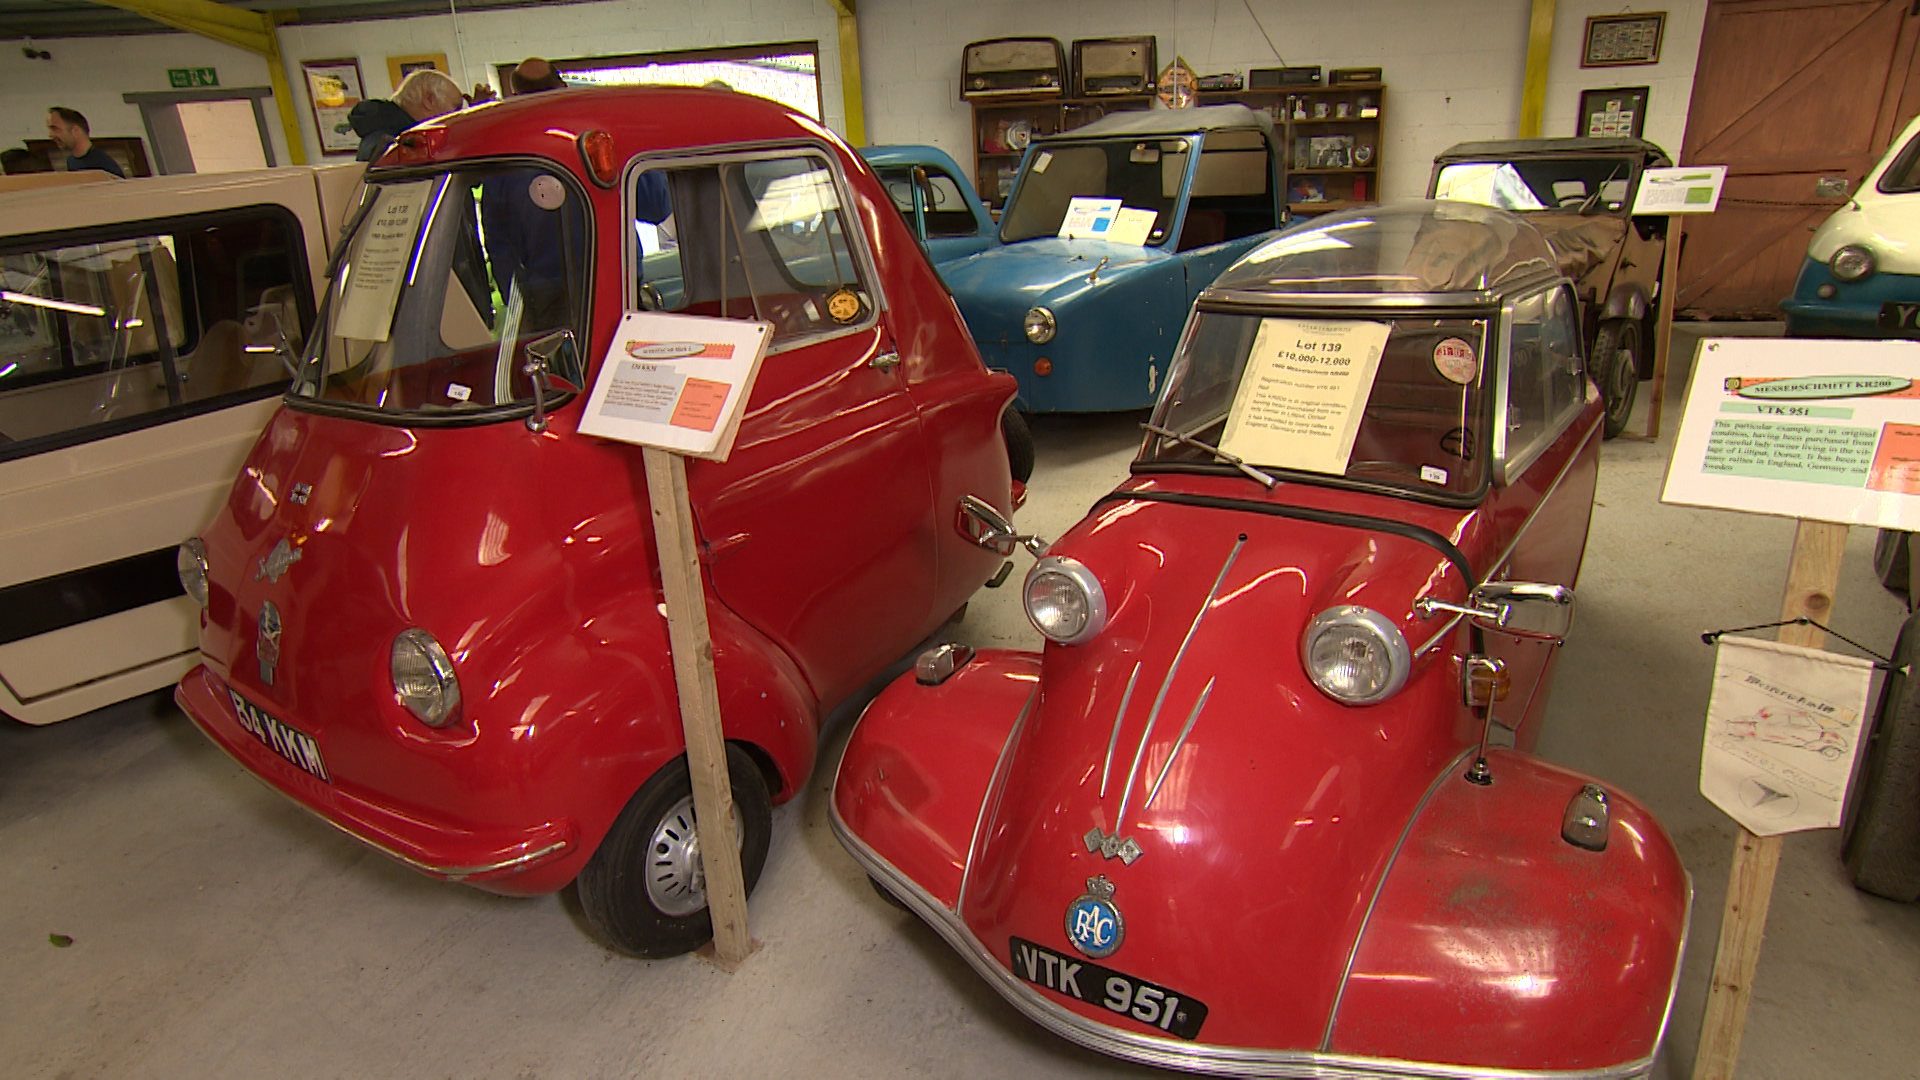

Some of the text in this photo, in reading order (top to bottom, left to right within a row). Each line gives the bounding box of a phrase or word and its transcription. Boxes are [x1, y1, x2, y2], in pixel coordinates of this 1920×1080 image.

[1296, 339, 1343, 352] Lot 139
[1277, 350, 1352, 366] £10,000-12,000
[1754, 380, 1892, 394] MESSERSCHMITT KR200
[1757, 405, 1810, 416] VTK 951
[1714, 420, 1730, 428] This
[1734, 423, 1773, 431] particular
[1776, 426, 1811, 434] example
[1828, 427, 1836, 435] in
[1841, 430, 1876, 438] original
[1752, 431, 1780, 440] having
[1782, 433, 1802, 442] been
[1805, 436, 1848, 445] purchased
[1754, 440, 1770, 449] lady
[1802, 444, 1826, 453] living
[1817, 454, 1832, 462] has
[1807, 463, 1847, 474] Germany
[263, 713, 327, 780] KKM
[1074, 905, 1114, 946] RAC
[1021, 944, 1180, 1030] VTK 951
